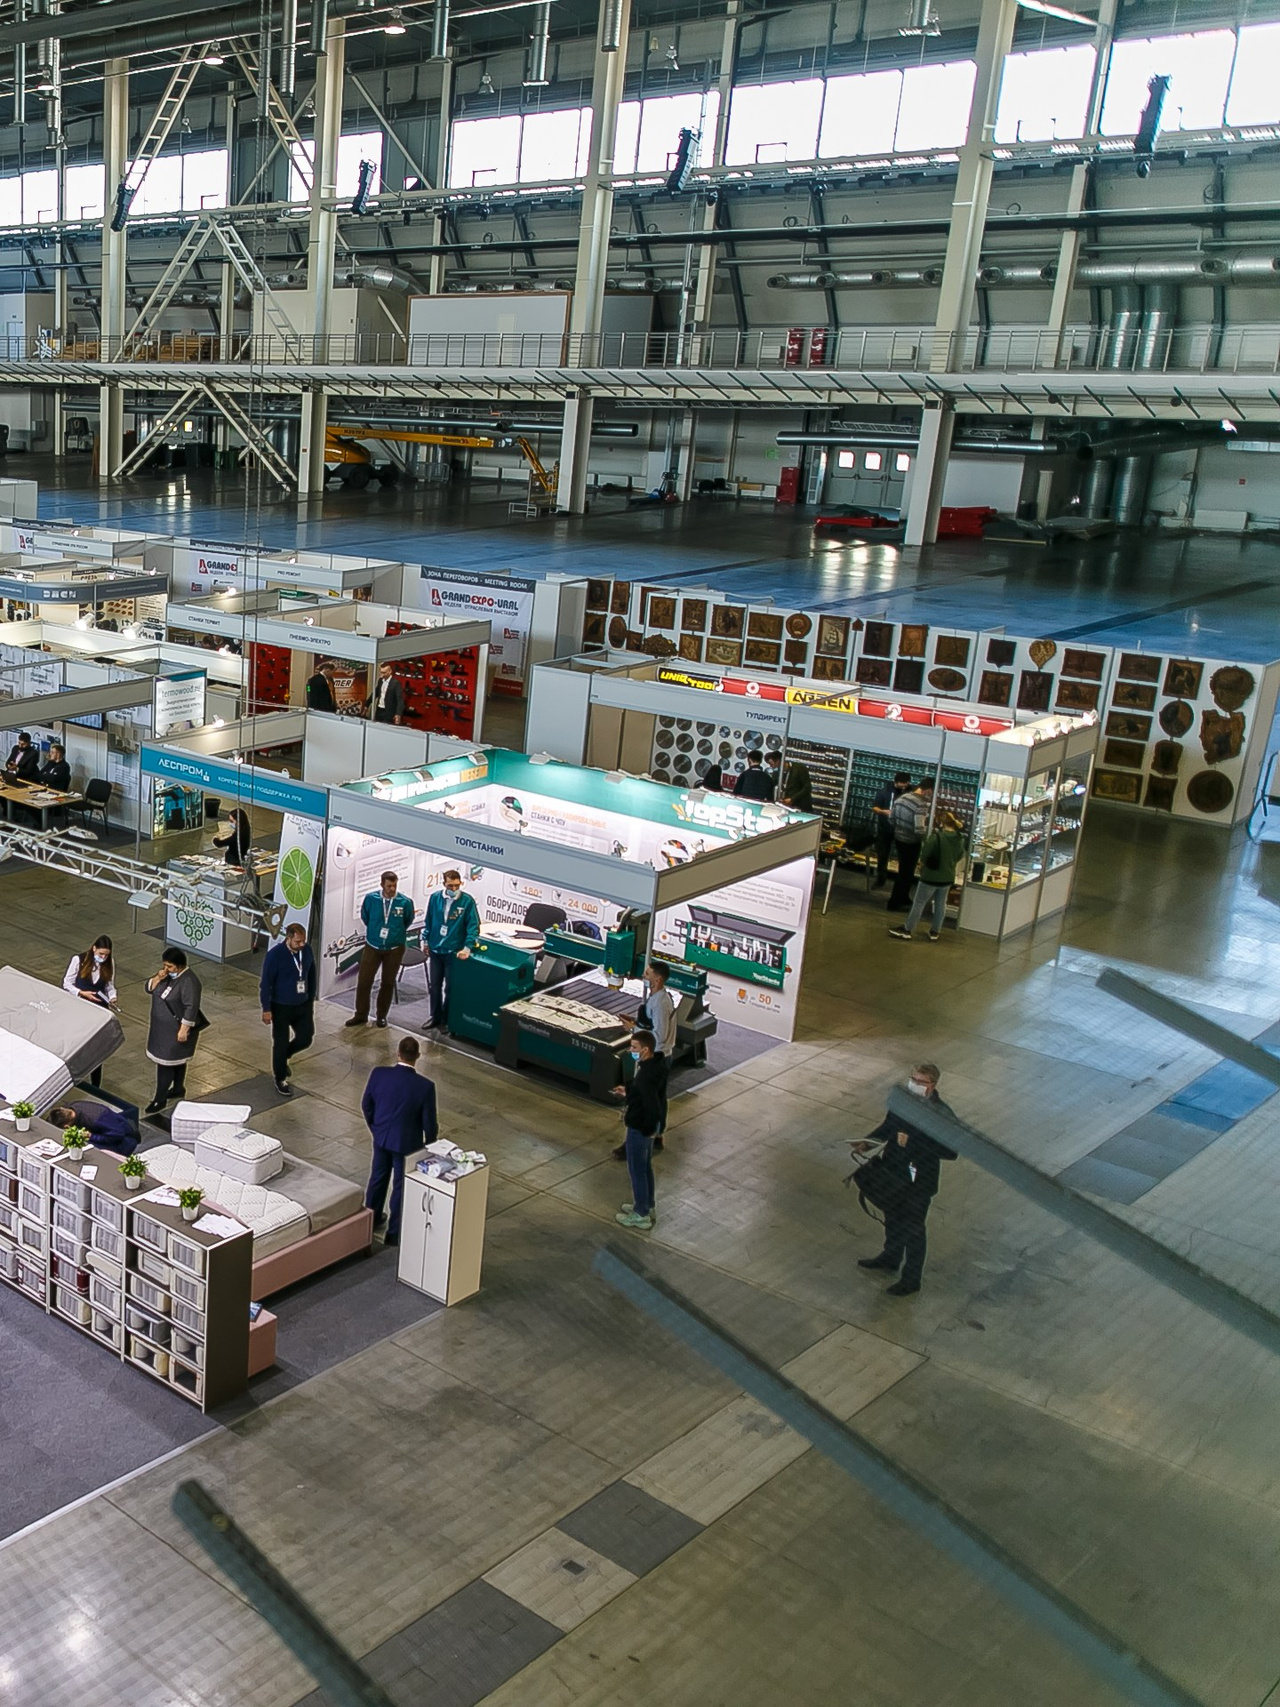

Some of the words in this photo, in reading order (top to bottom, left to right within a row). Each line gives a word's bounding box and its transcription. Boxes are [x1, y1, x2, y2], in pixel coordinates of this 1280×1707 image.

[443, 572, 478, 583] ПЕРЕГОВОРОВ
[484, 578, 508, 587] MEETING
[289, 634, 332, 646] ПНЕВМО-ЭЛЕКТРО
[746, 711, 787, 724] ТУЛДИРЕКТ
[158, 758, 203, 777] ЛЕСПРОМ
[257, 786, 290, 798] ПОДДЕРЖКА
[455, 836, 504, 855] ТОПСТАНКИ
[487, 896, 528, 916] ОБОРУДОВ
[759, 994, 772, 1005] 50
